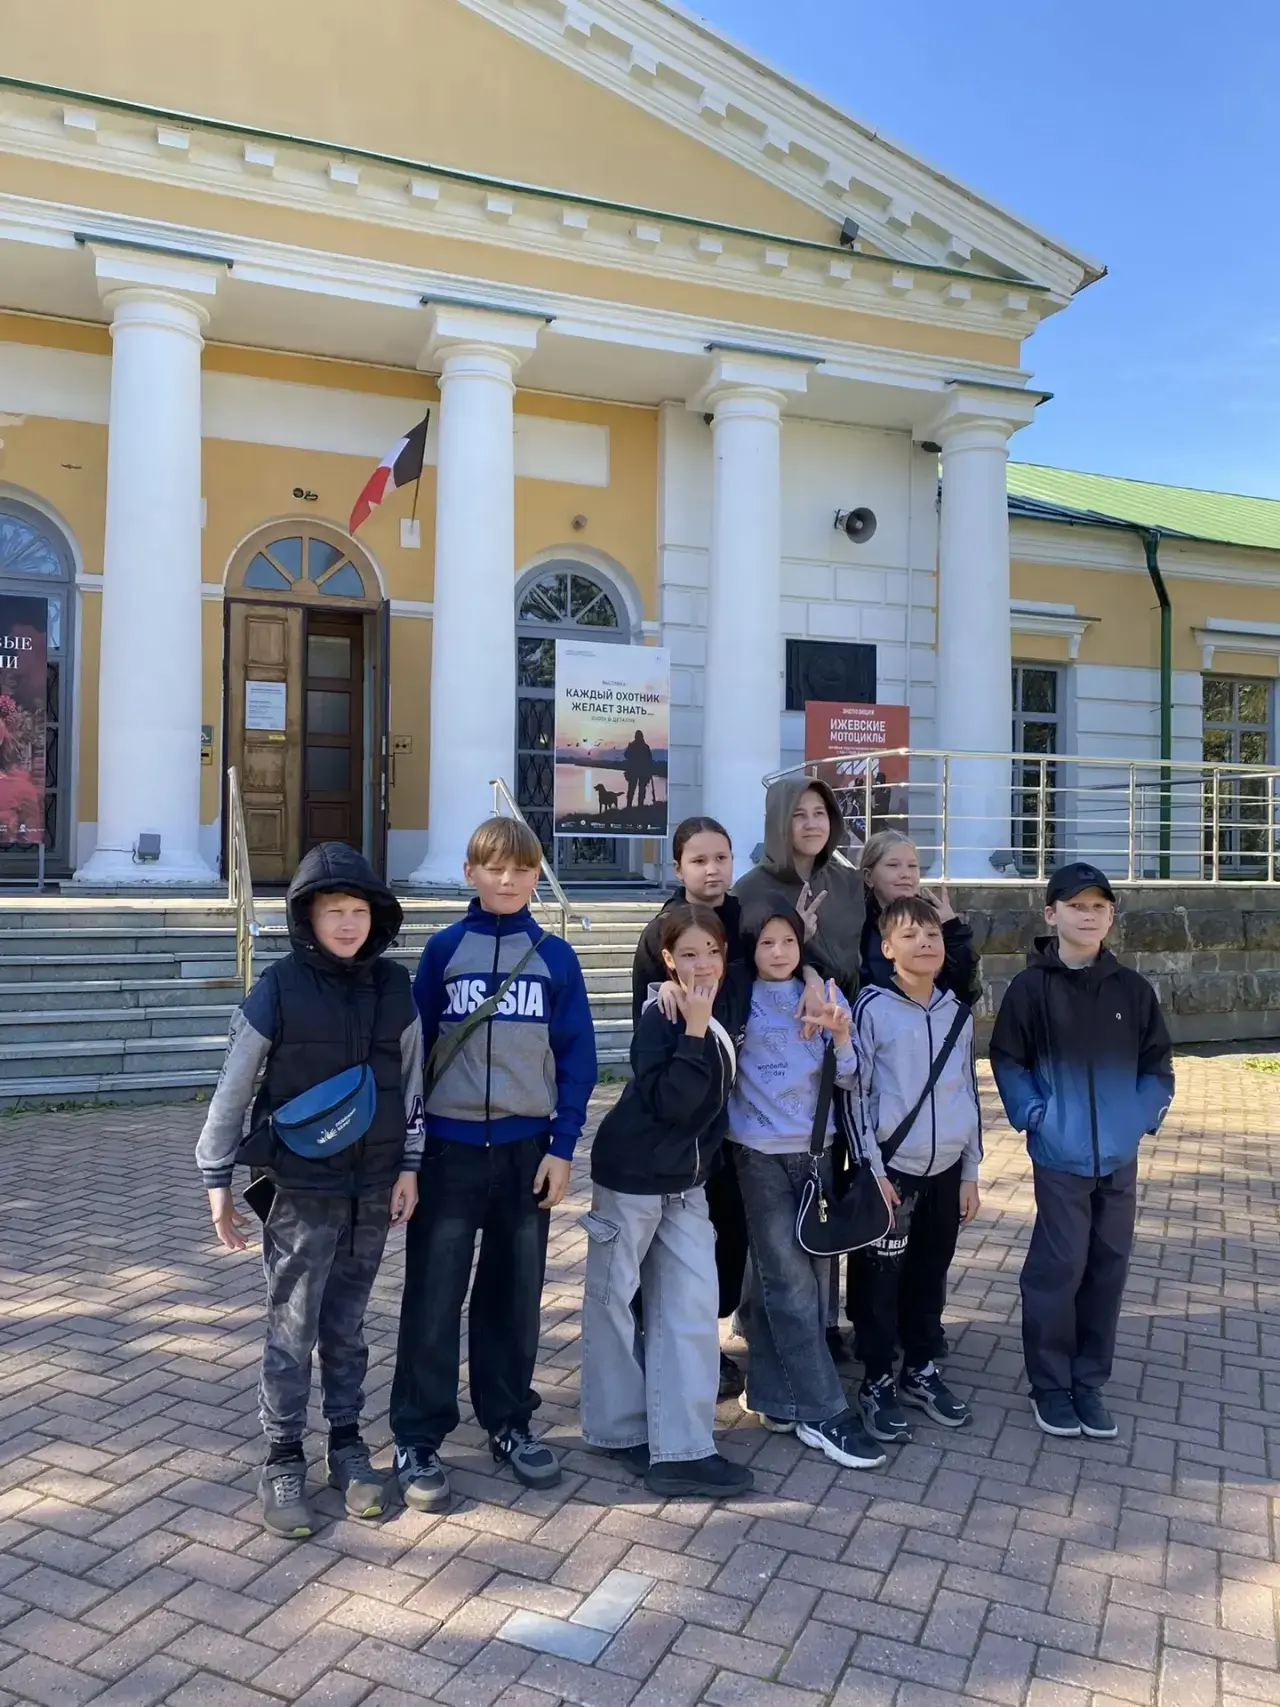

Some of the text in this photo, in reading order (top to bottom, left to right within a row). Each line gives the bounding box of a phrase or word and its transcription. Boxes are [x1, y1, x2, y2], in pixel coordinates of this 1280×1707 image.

[566, 688, 660, 703] КАЖДЫЙ ОХОТНИК
[572, 702, 614, 713] ЖЕЛАЕТ
[830, 718, 886, 732] ИЖЕВСКИЕ
[830, 731, 886, 744] МОТОЦИКЛЫ
[757, 1061, 788, 1071] wonderful
